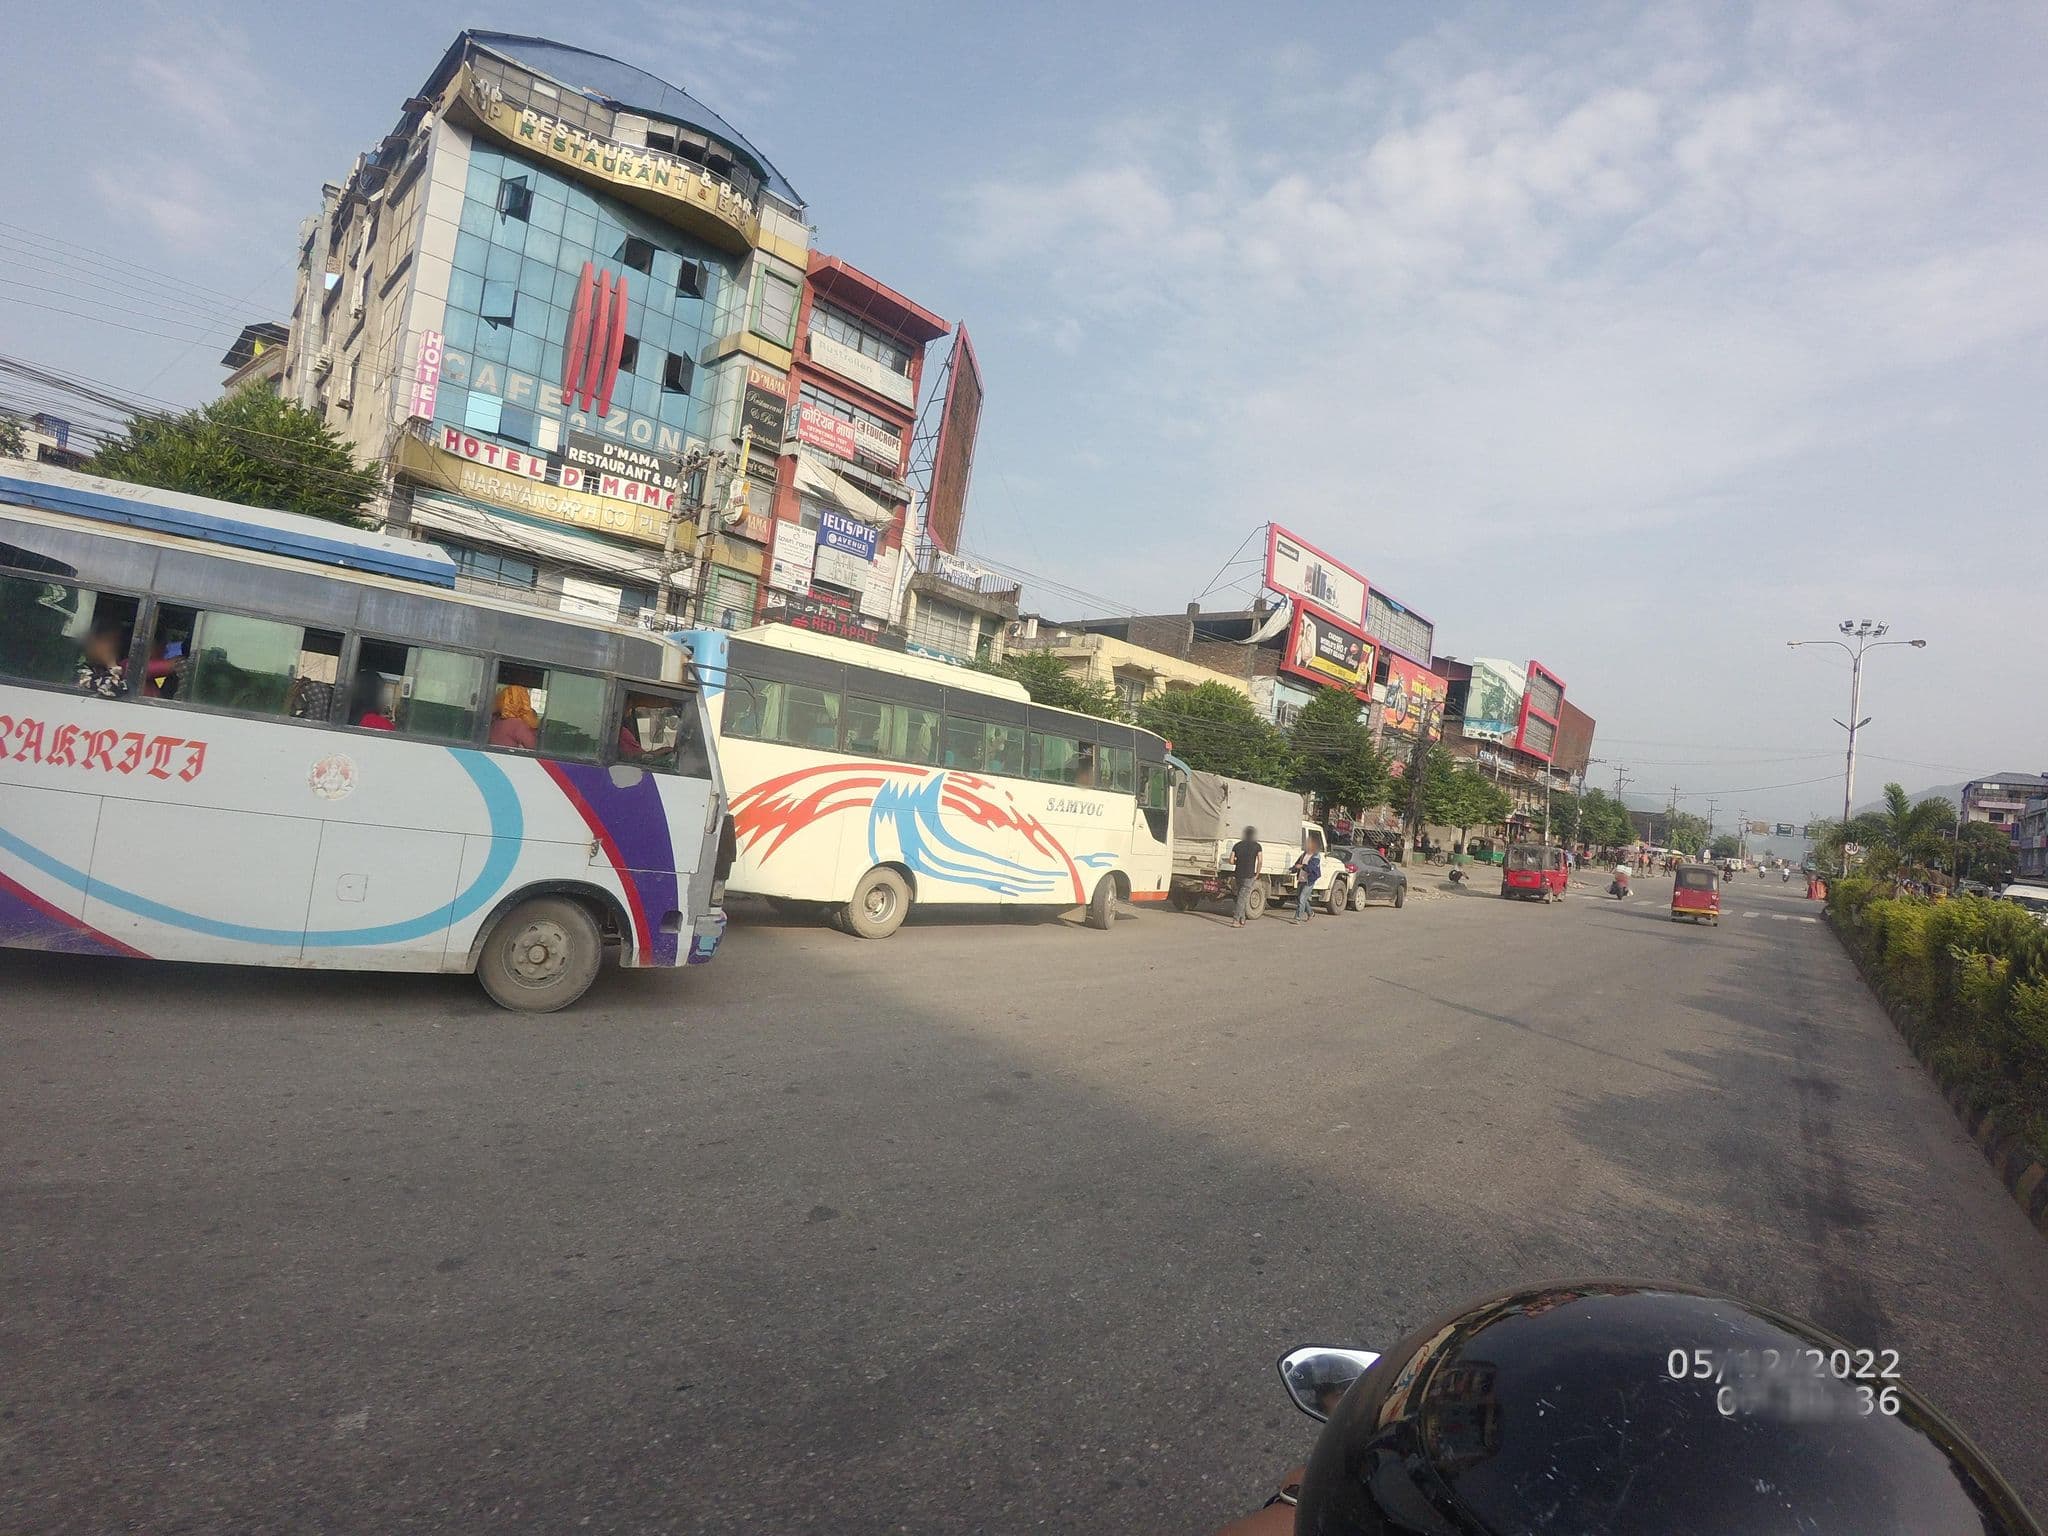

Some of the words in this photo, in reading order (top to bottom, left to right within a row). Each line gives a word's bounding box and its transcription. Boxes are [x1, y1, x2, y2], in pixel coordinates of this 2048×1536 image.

[522, 106, 690, 179] RESTAURANT
[719, 182, 754, 218] BAR
[418, 330, 442, 421] HOTEL
[445, 429, 542, 478] HOTEL
[563, 467, 580, 486] D
[568, 447, 652, 482] RESTAURANT
[652, 472, 661, 484] &
[603, 443, 660, 470] D'MAMA
[823, 512, 875, 543] IELTS/PTE
[812, 615, 838, 634] RED
[840, 624, 879, 645] APPLE
